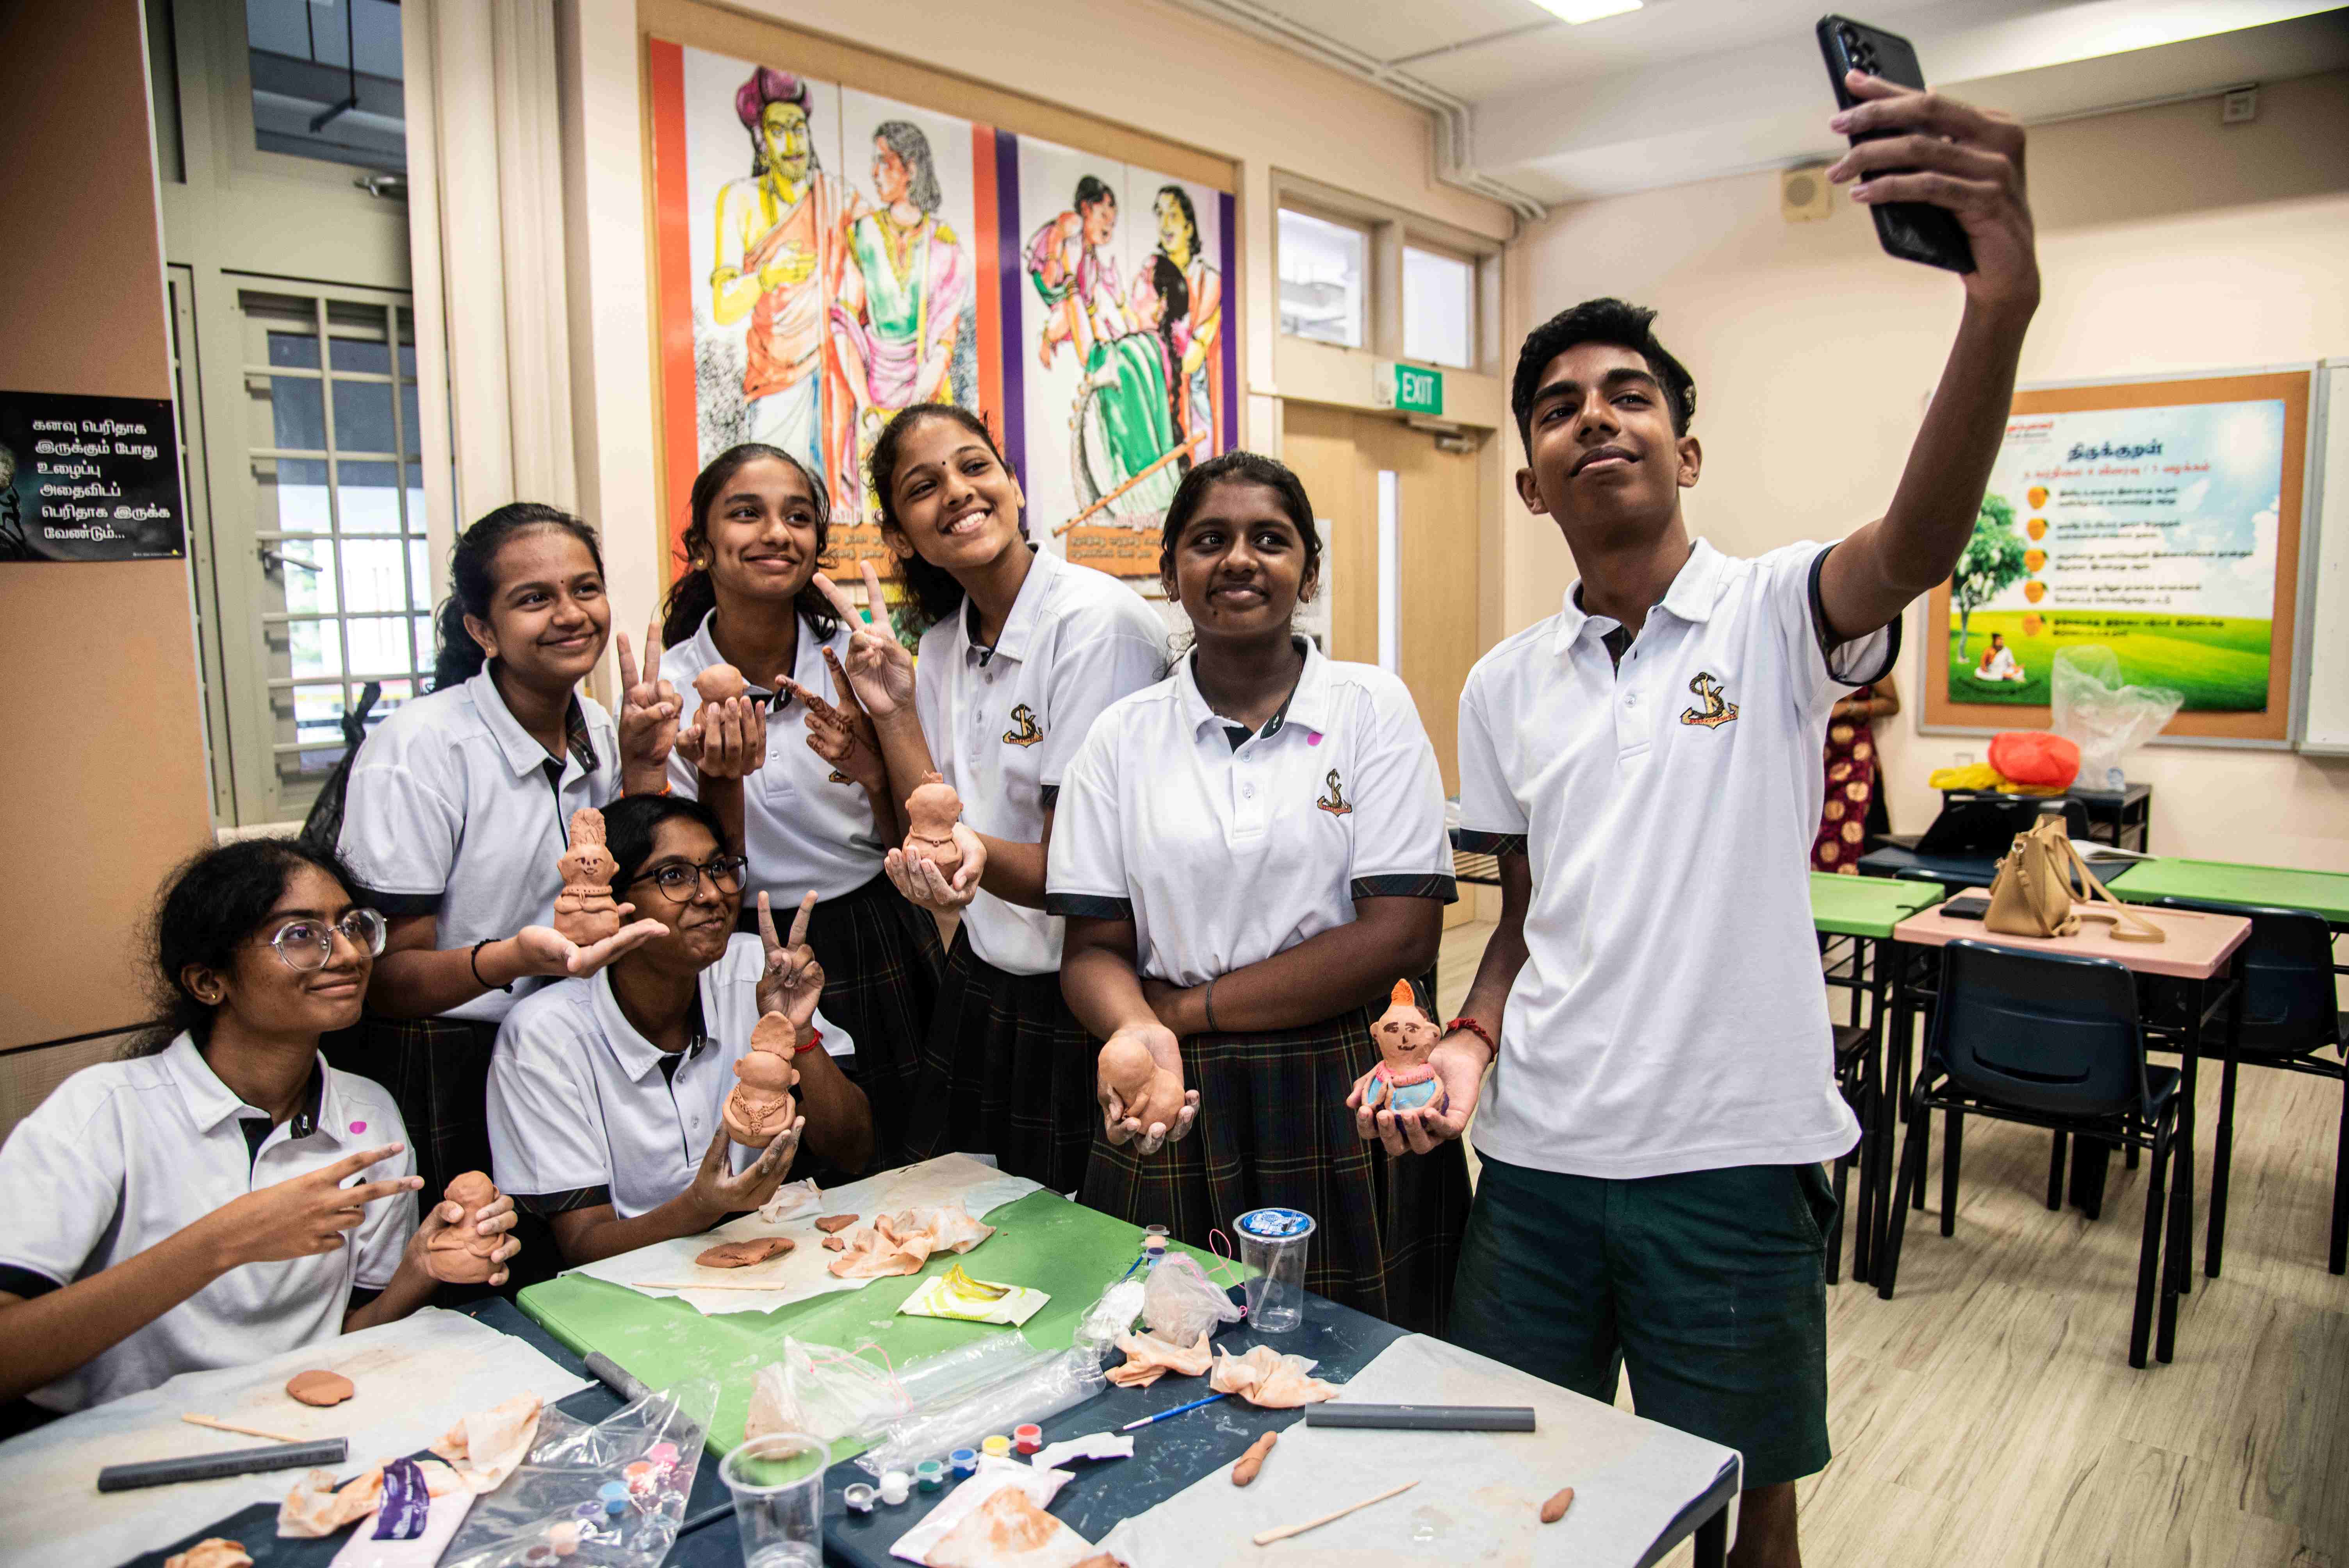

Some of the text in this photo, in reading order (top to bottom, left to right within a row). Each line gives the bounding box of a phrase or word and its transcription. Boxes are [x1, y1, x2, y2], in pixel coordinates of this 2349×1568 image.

[1402, 372, 1434, 404] EXIT
[33, 419, 147, 437] கனவு பெரிதாக
[35, 437, 158, 460] இருக்கும் போது
[2067, 438, 2163, 463] திருக்குறள்
[37, 459, 101, 479] உழைப்பு
[40, 481, 121, 500] அதைவிடப்
[41, 502, 171, 521] பெரிதாக இருக்க
[44, 523, 125, 542] வேண்டும்...
